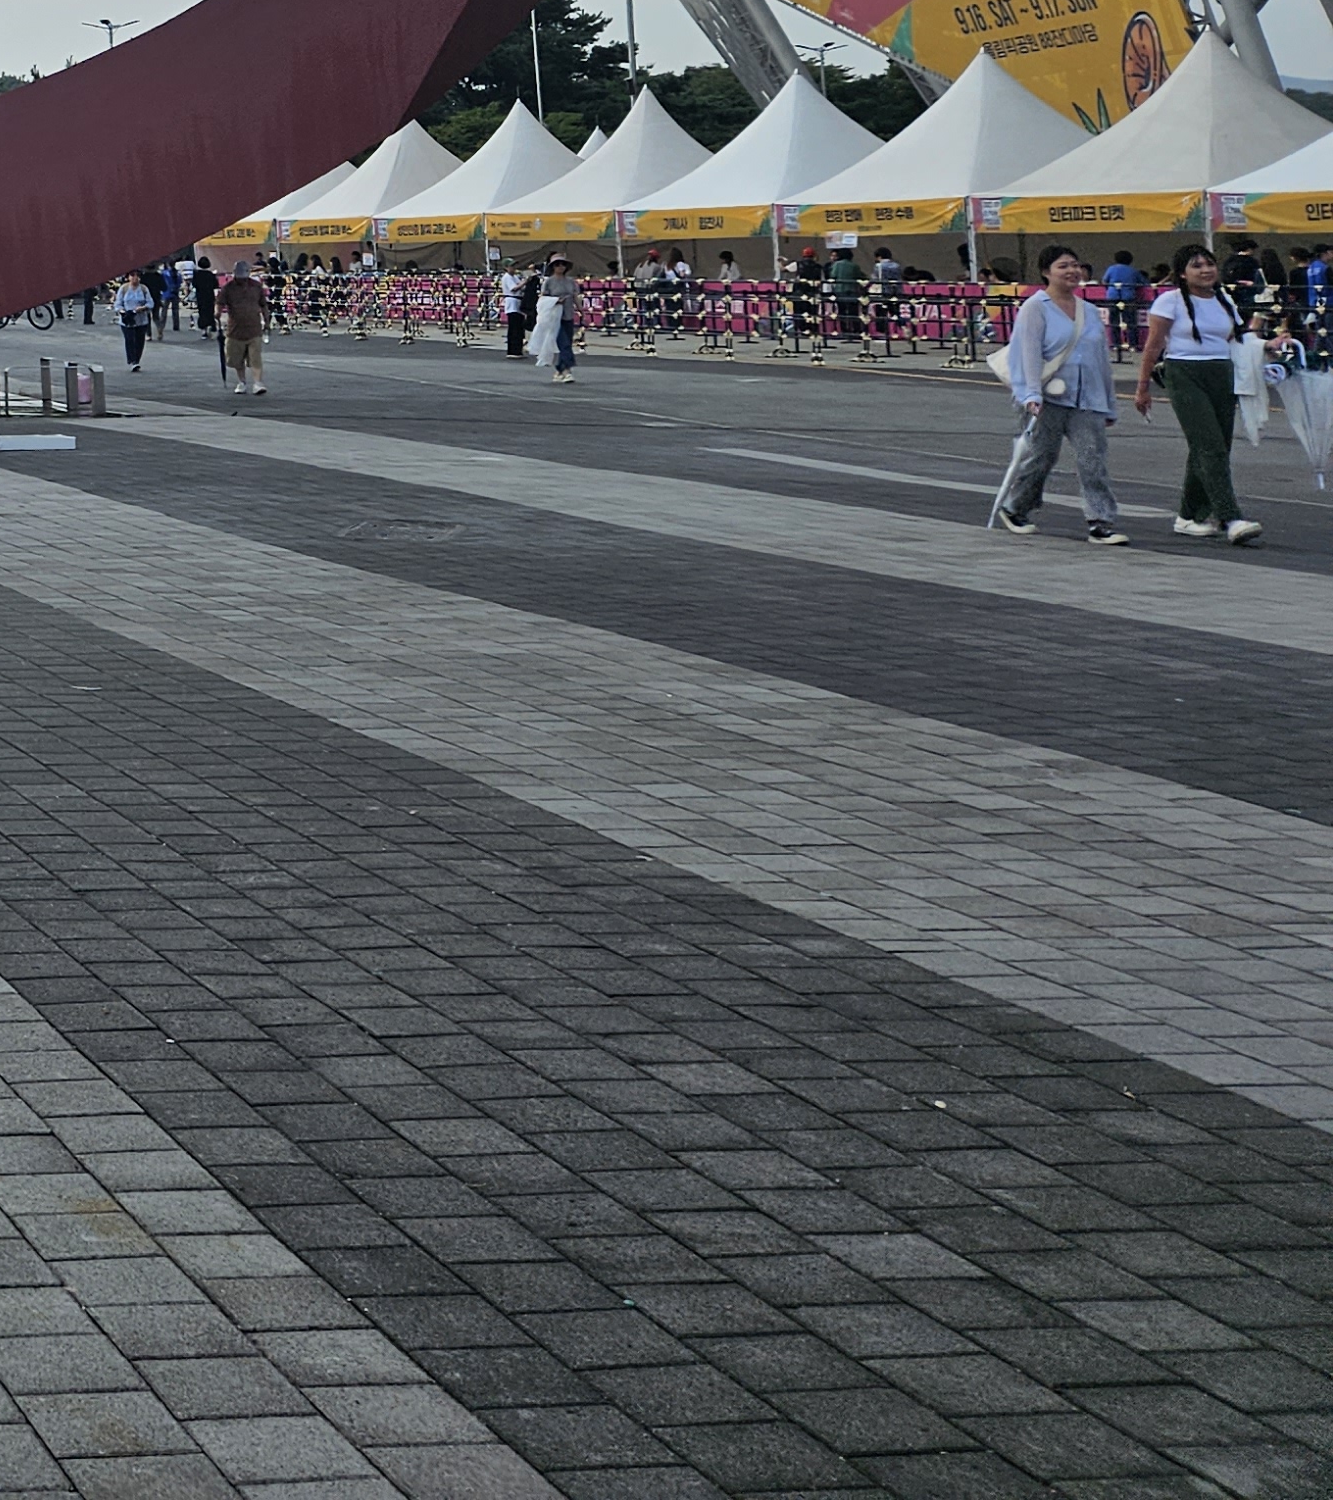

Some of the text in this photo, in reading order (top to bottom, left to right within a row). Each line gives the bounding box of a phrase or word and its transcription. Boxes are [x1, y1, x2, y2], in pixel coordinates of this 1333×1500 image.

[953, 6, 994, 36] 9.16.
[981, 21, 1100, 61] 올림픽공원 88잔디마당
[1048, 204, 1126, 223] 인터파크 티켓
